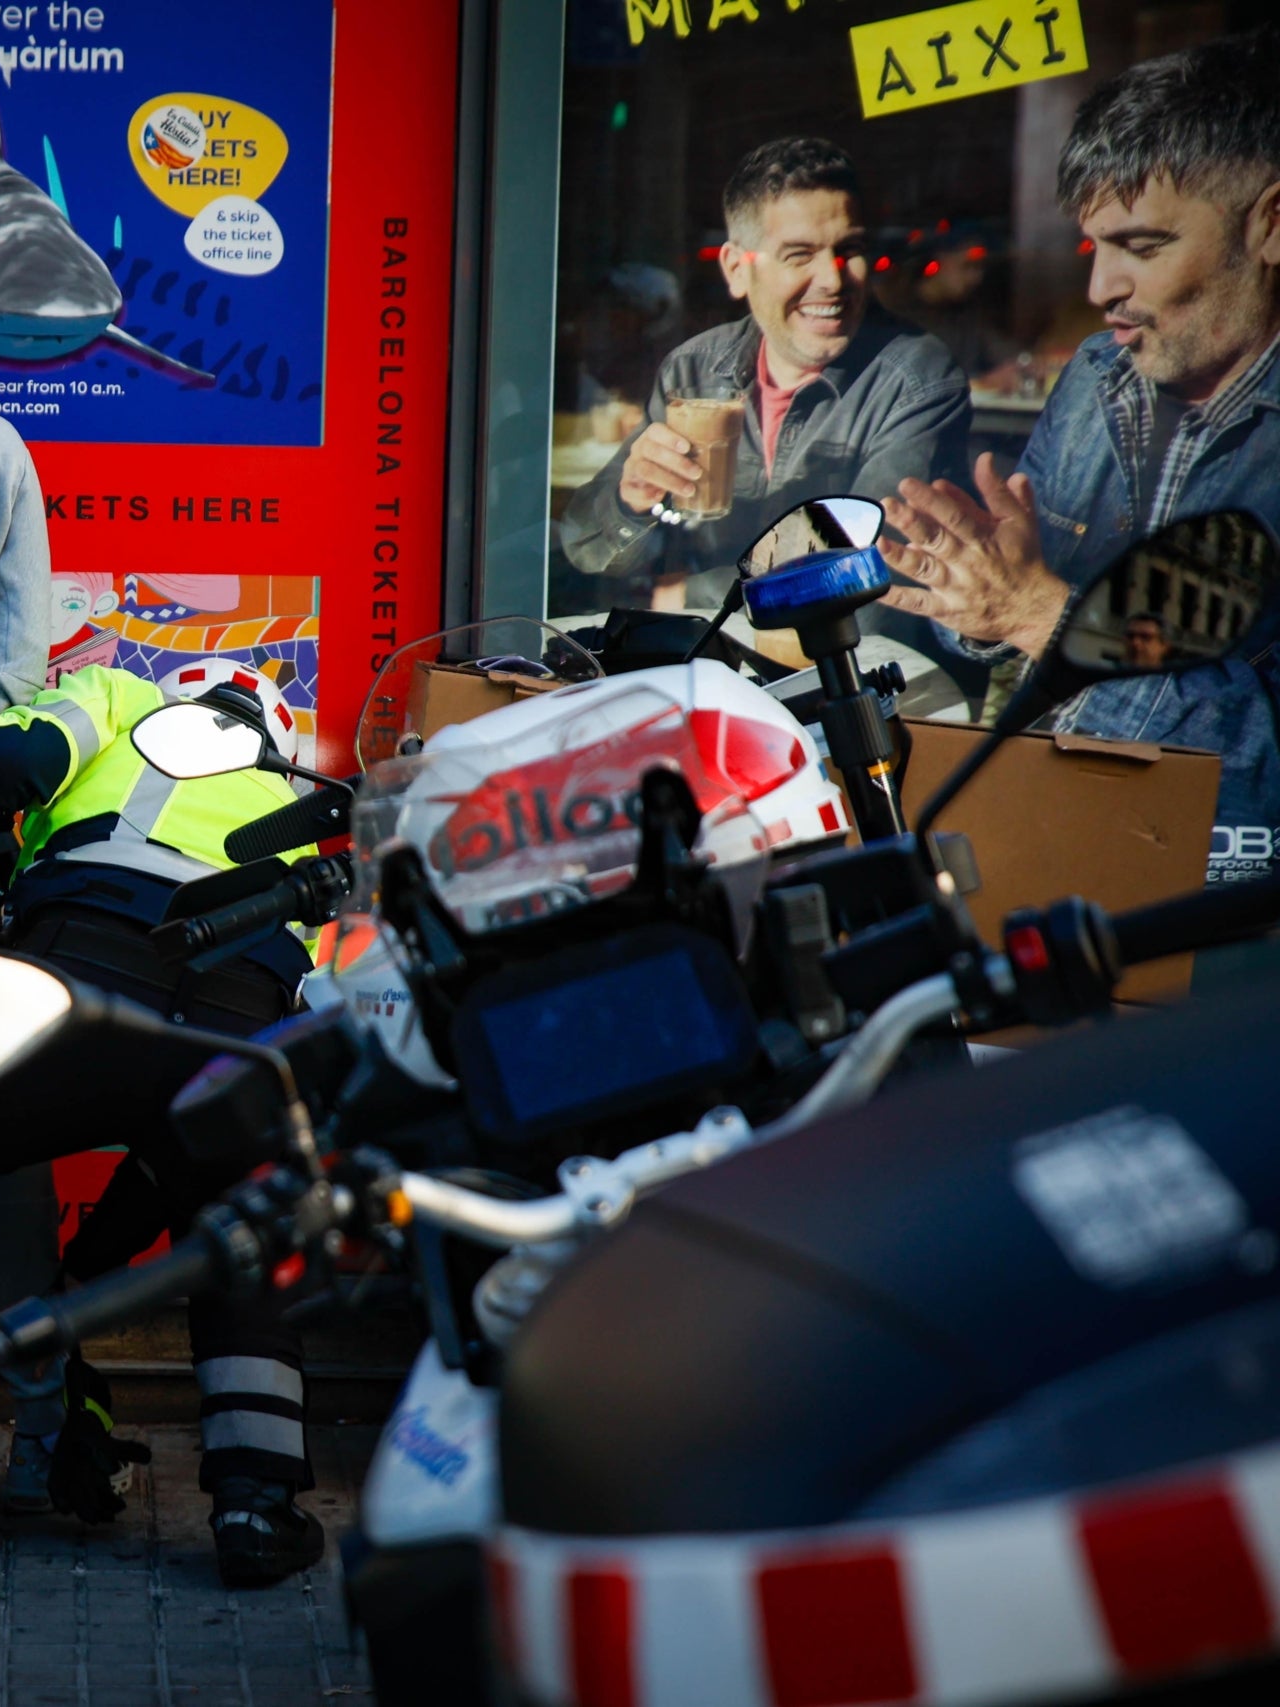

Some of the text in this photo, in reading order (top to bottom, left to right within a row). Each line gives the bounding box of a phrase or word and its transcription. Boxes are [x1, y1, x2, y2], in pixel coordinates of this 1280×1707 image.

[47, 1, 105, 31] the
[199, 110, 232, 129] UY
[168, 168, 241, 187] HERE!
[217, 209, 260, 225] & skip
[203, 229, 273, 242] the ticket
[202, 246, 273, 260] office line
[376, 217, 409, 476] BARCELONA
[26, 379, 65, 394] from
[70, 380, 88, 394] 10
[91, 382, 126, 395] a.m.
[45, 494, 151, 522] KETS
[172, 497, 282, 524] HERE
[371, 497, 401, 675] TICKETS
